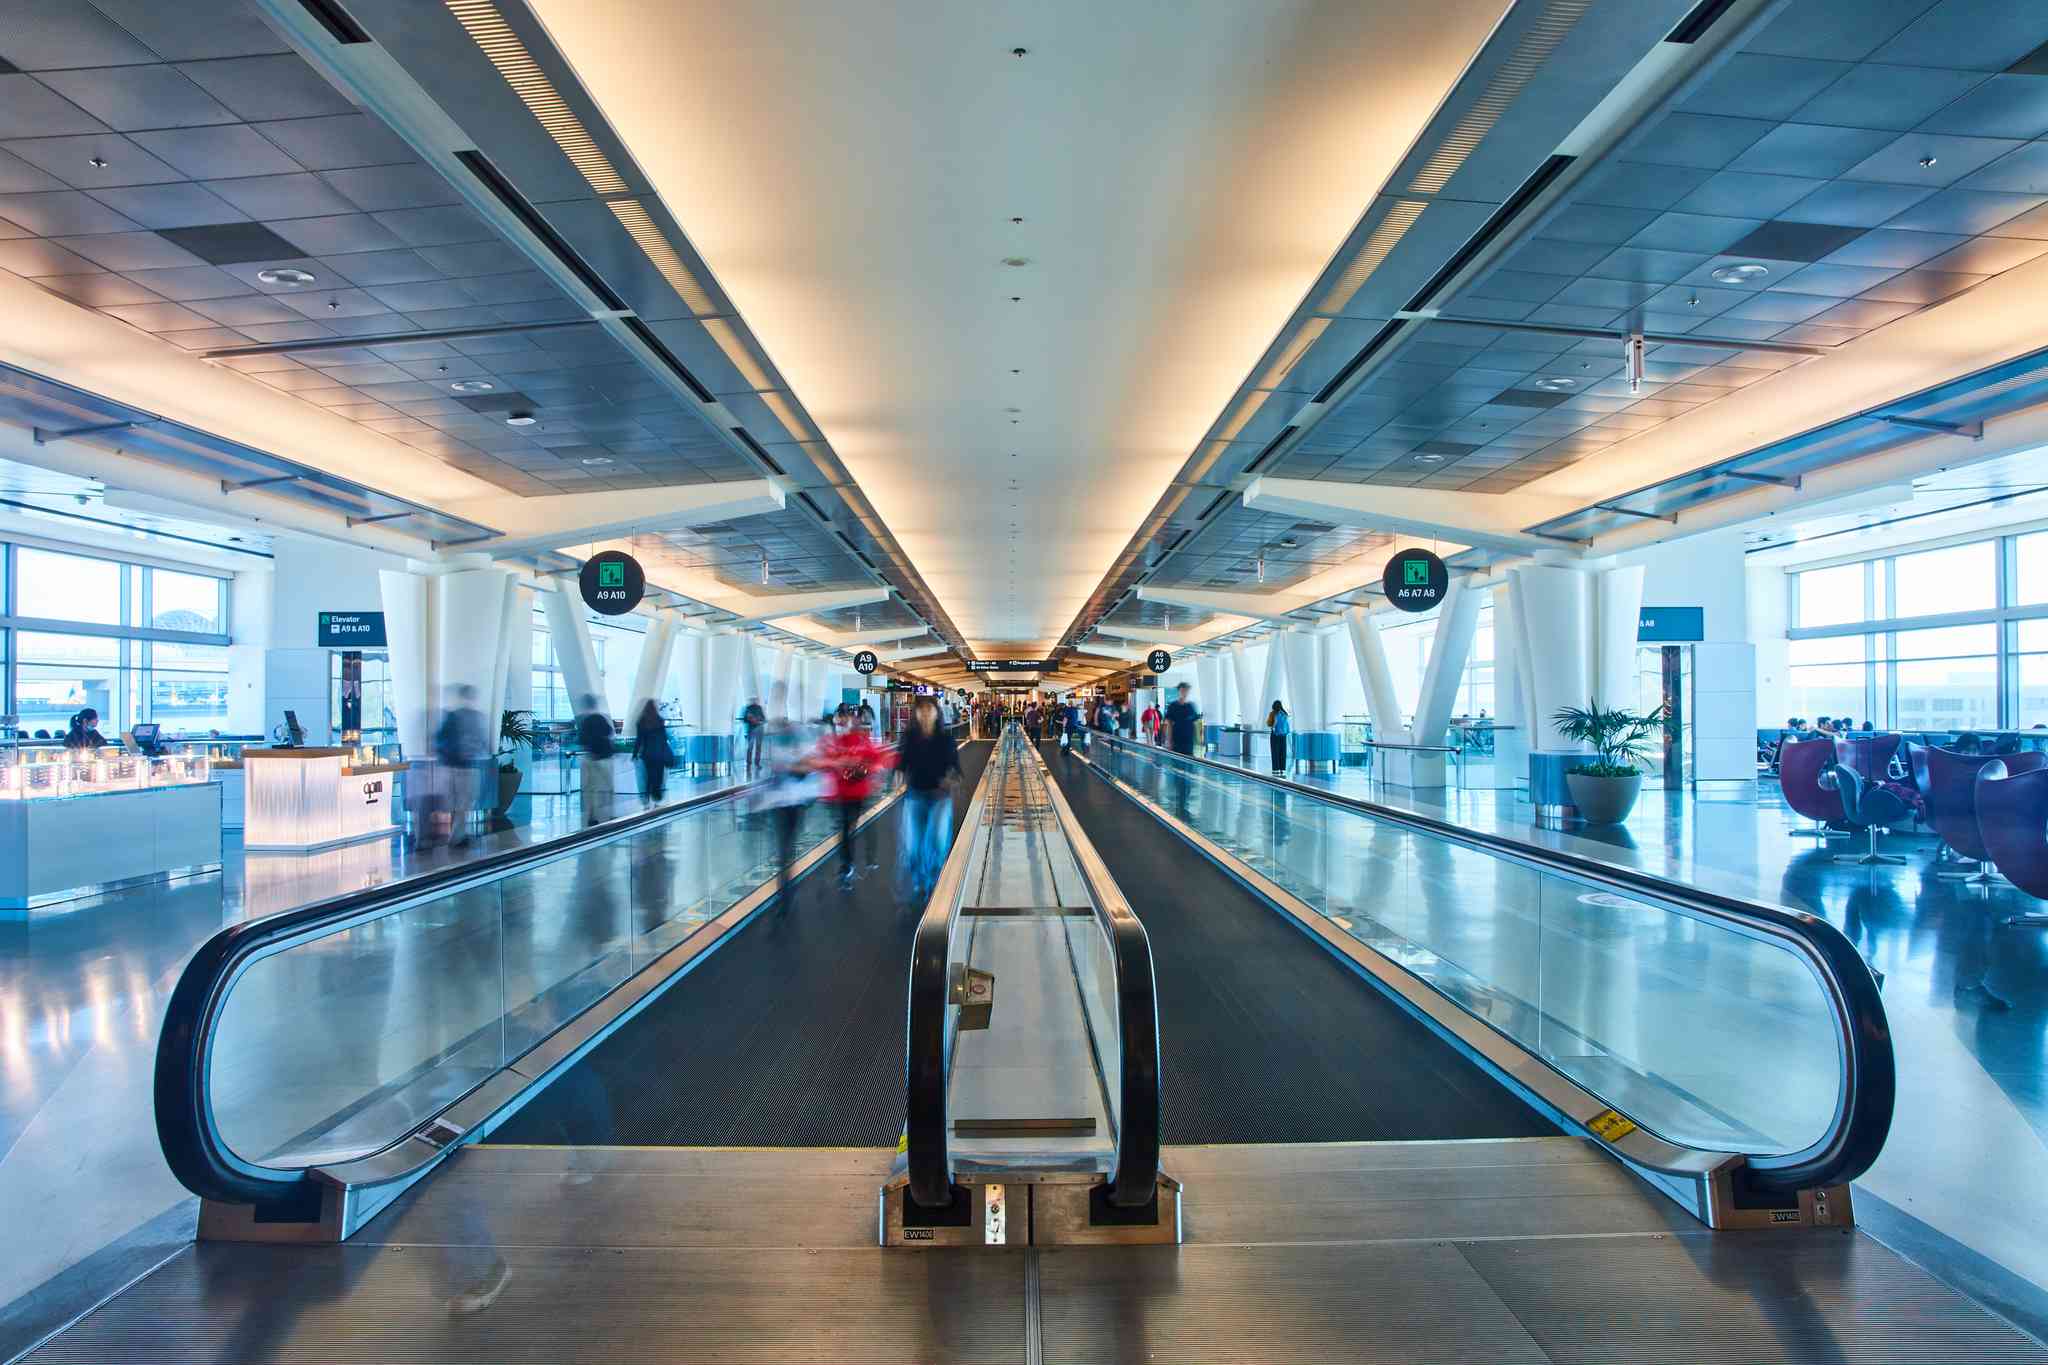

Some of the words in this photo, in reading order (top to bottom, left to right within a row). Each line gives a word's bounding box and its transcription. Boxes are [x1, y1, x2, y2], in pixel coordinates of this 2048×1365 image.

[597, 591, 609, 600] A9
[610, 591, 626, 600] A10
[1398, 589, 1409, 597] A6
[1411, 589, 1422, 597] A7
[1424, 589, 1435, 597] A8
[331, 615, 360, 623] Elevator
[860, 654, 872, 662] A9
[858, 663, 874, 671] A10
